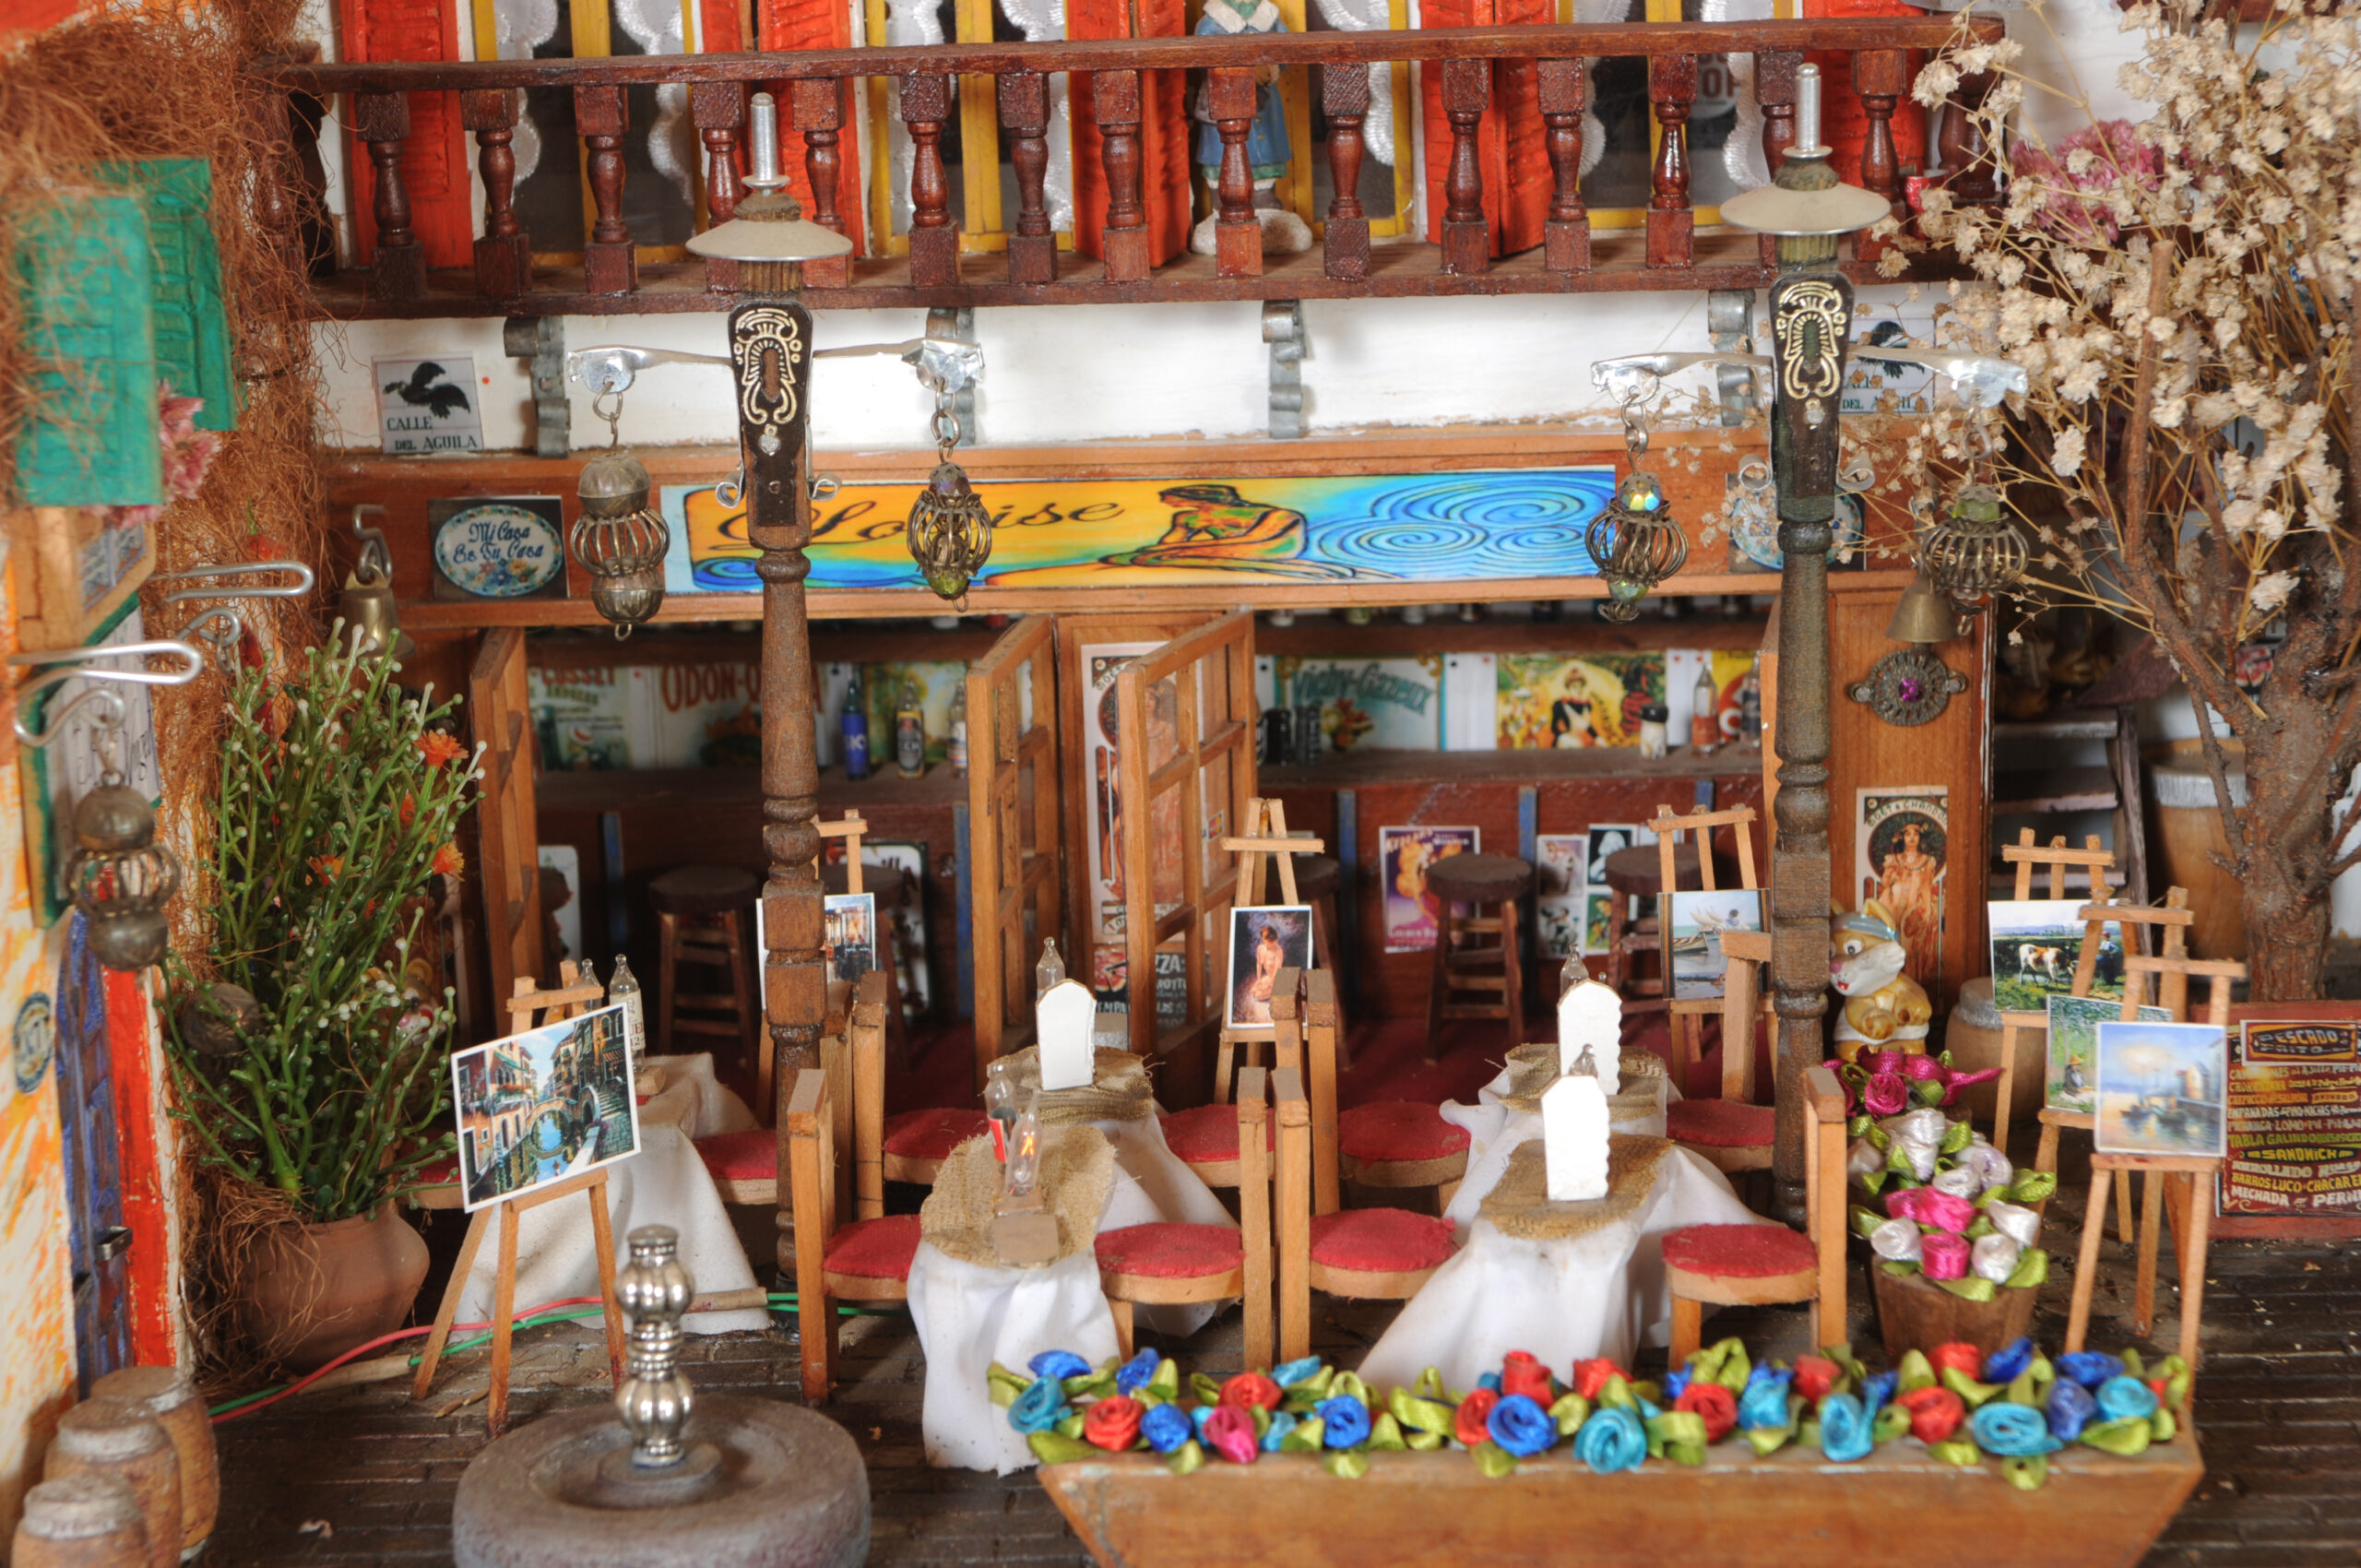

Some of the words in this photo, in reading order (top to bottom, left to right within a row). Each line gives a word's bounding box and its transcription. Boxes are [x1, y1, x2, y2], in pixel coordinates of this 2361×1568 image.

[1843, 398, 1863, 409] DEL
[387, 416, 433, 432] CALLE
[395, 440, 417, 451] DEL
[423, 435, 478, 450] AGUILA
[497, 521, 530, 541] Casa
[507, 541, 544, 559] Casa
[2257, 1030, 2339, 1044] PESCADO
[2228, 1134, 2265, 1148] TABLA
[2232, 1172, 2271, 1189] BARROS
[2272, 1180, 2302, 1194] LUCO
[2307, 1174, 2361, 1193] CHACARE
[2232, 1184, 2289, 1206] MECHADA
